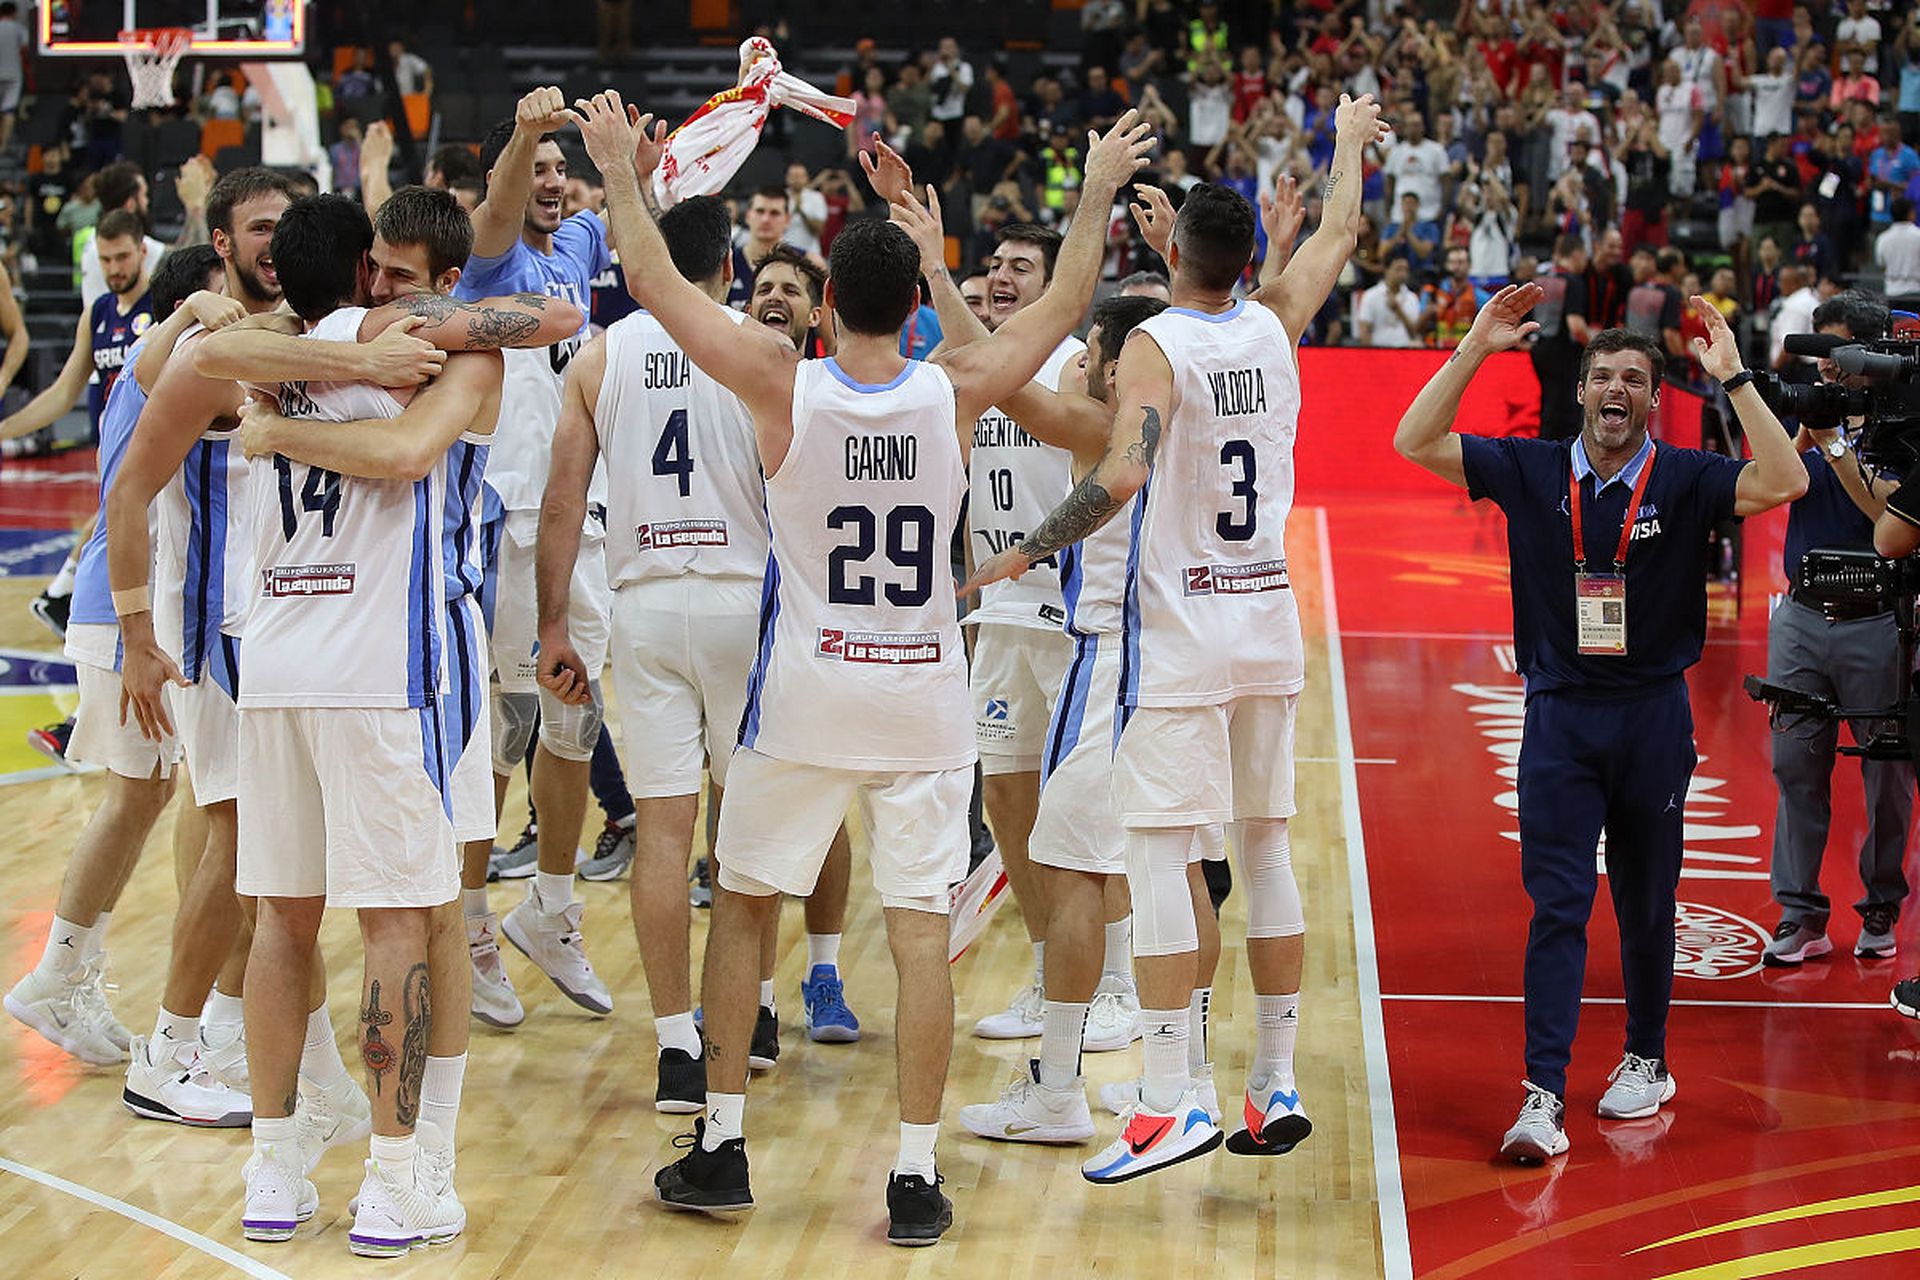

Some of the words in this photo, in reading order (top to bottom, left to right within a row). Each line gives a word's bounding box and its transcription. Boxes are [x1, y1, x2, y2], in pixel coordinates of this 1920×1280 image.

[645, 352, 690, 389] SCOLA
[1207, 368, 1267, 417] VILDOZA
[973, 417, 1040, 448] RGENTINA
[652, 409, 695, 497] 4
[845, 435, 917, 480] GARINO
[273, 453, 342, 543] 14
[989, 468, 1014, 511] 10
[1216, 440, 1258, 541] 3
[827, 505, 936, 607] 29
[290, 575, 351, 594] egunda
[1188, 566, 1211, 590] 2
[1232, 570, 1289, 591] segund
[820, 628, 844, 654] 2
[868, 645, 937, 663] segunda
